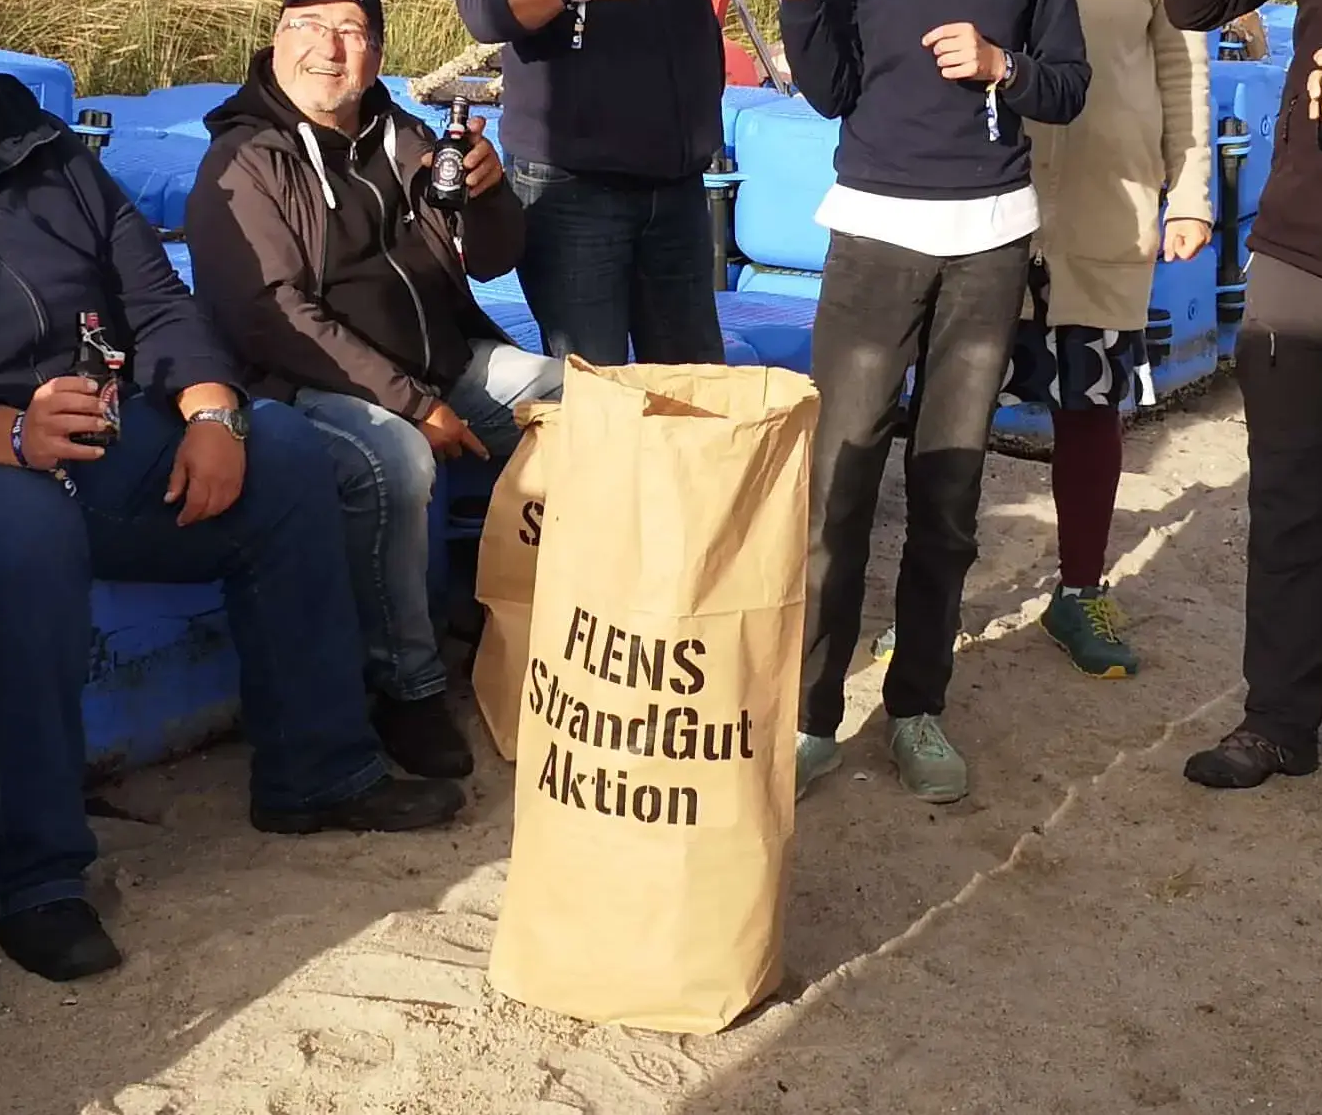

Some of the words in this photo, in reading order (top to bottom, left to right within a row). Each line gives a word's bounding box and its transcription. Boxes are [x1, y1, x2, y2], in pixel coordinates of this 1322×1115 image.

[564, 606, 706, 695] FLENS
[529, 658, 754, 761] StrandGut
[538, 741, 698, 826] Aktion
